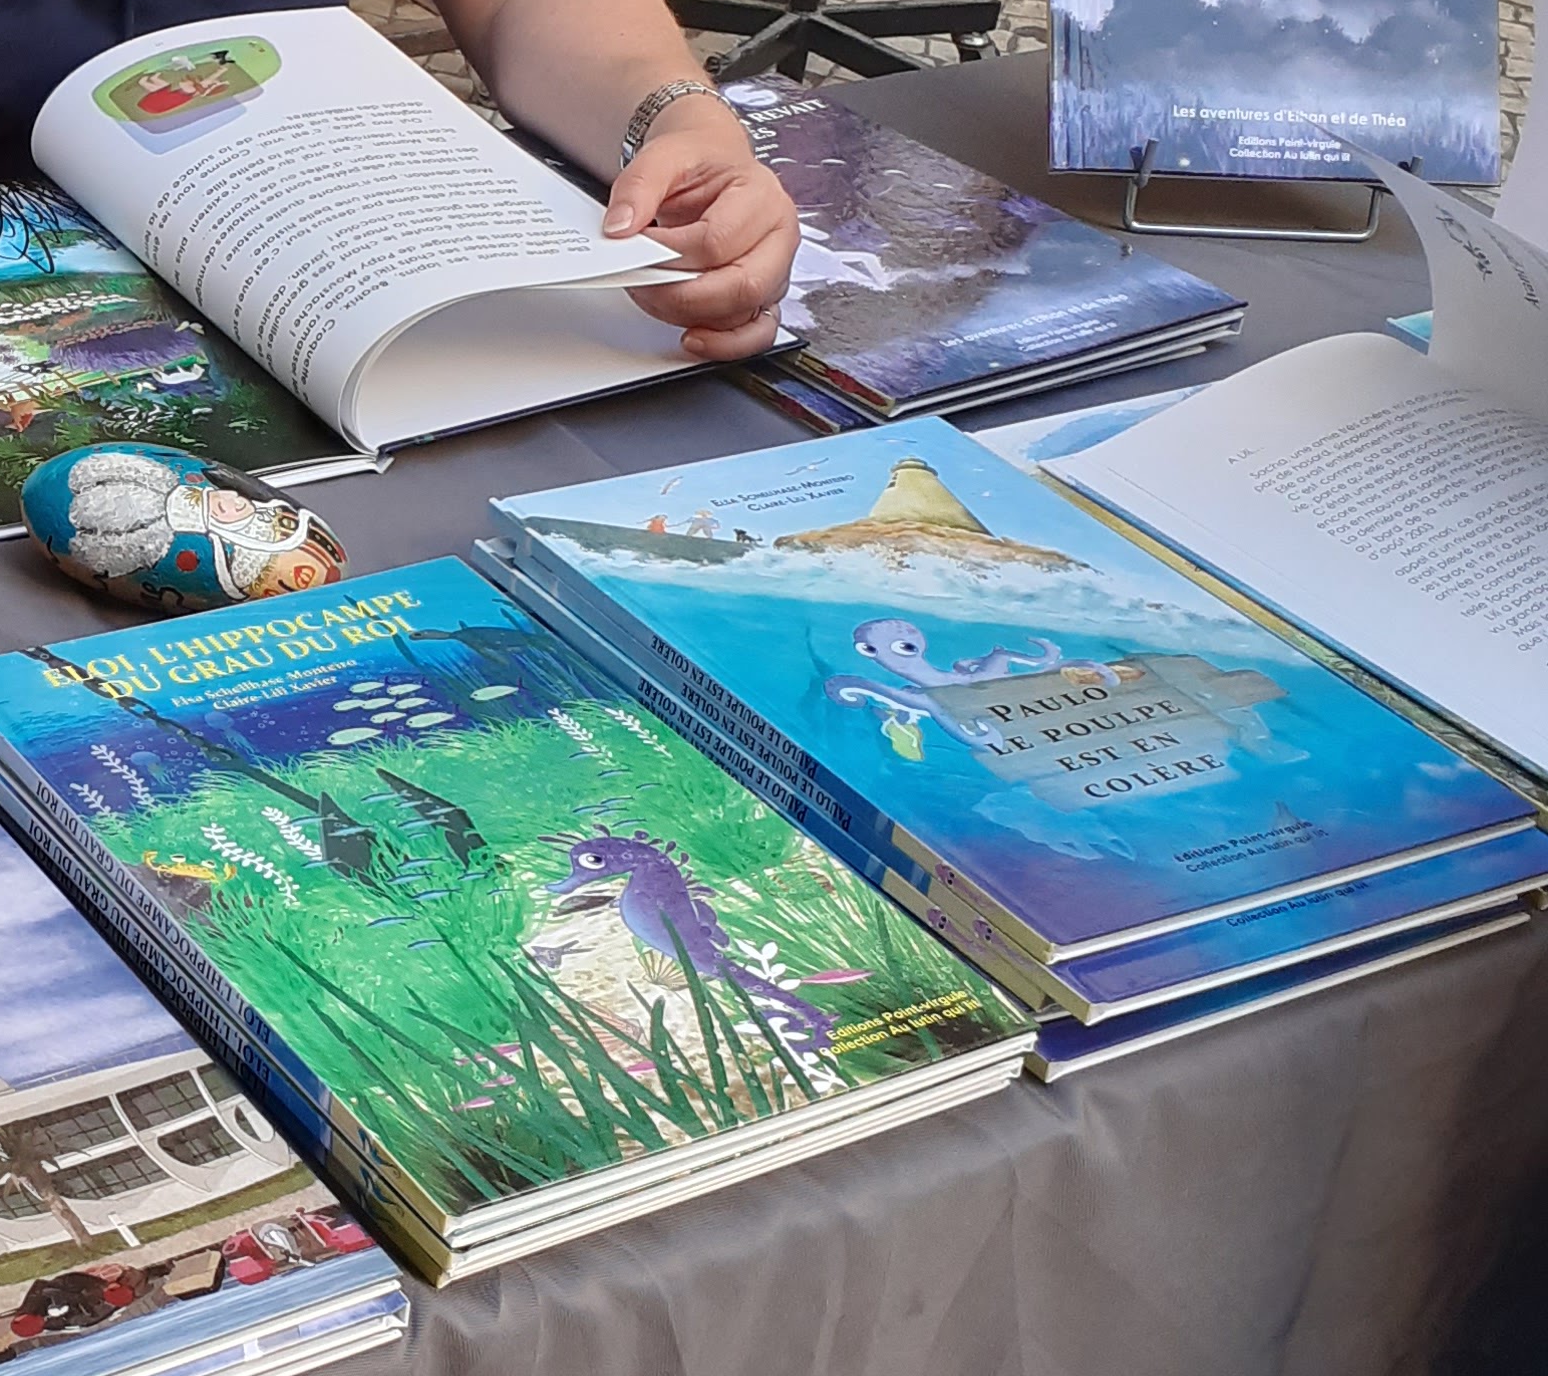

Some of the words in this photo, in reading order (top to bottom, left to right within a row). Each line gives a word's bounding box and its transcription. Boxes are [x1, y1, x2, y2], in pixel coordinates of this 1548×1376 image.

[1173, 104, 1196, 118] Les
[1199, 105, 1270, 122] aventures
[1331, 111, 1346, 125] et
[1348, 111, 1369, 126] de
[1371, 112, 1407, 128] Théa
[147, 589, 422, 666] L'HIPPOCAMPE
[98, 670, 162, 700] DU
[167, 647, 276, 685] GRAU
[277, 631, 338, 661] DU
[340, 614, 416, 647] ROI
[985, 735, 1035, 756] LE
[1040, 699, 1183, 743] POULPE
[987, 686, 1108, 723] PAULO
[1056, 745, 1124, 772] EST
[1129, 731, 1182, 753] EN
[1084, 752, 1226, 798] COLÈRE
[825, 1015, 885, 1041] Editions
[881, 988, 968, 1023] Point-virgule
[889, 1022, 912, 1036] Au
[908, 1012, 942, 1029] lutin
[941, 1003, 966, 1020] qui
[965, 999, 983, 1012] lit
